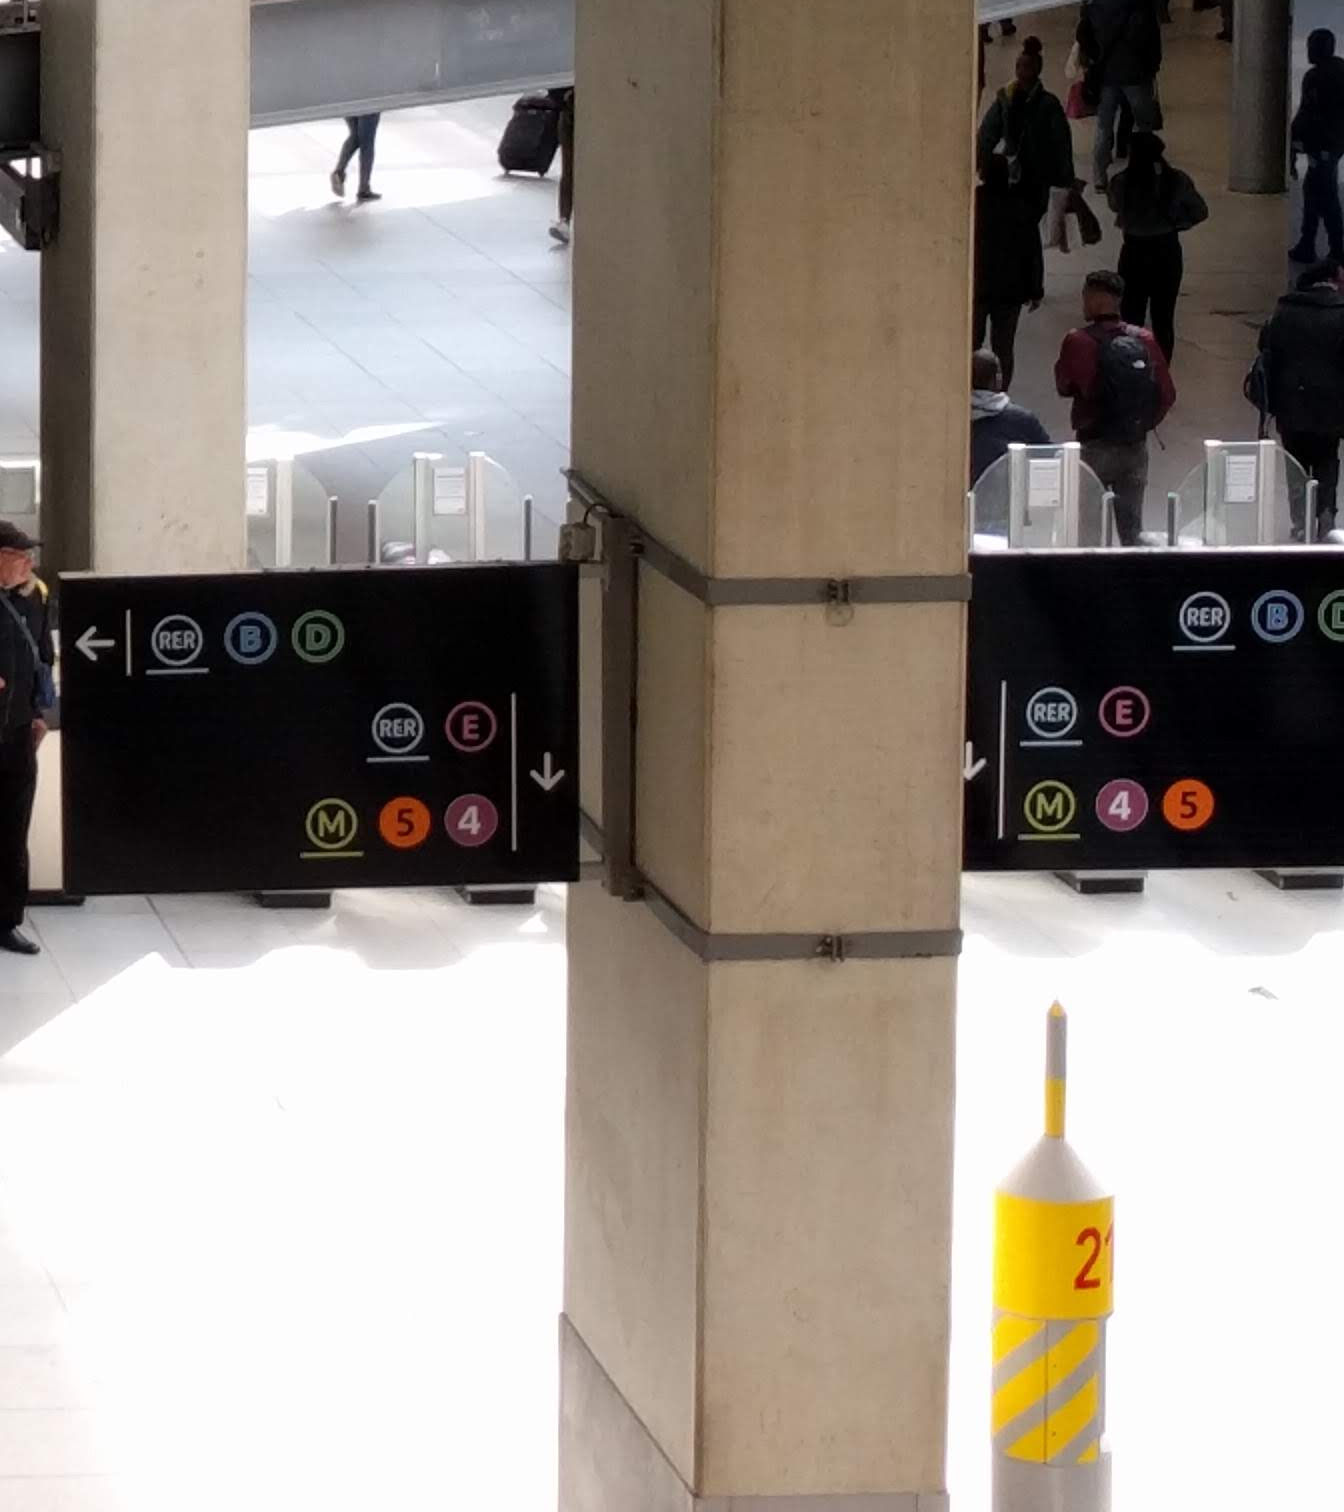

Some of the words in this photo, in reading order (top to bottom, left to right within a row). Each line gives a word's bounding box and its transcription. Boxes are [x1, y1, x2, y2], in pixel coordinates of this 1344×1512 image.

[1186, 605, 1224, 628] RER
[158, 628, 197, 652] RER
[1032, 702, 1072, 724] RER
[378, 717, 418, 741] RER
